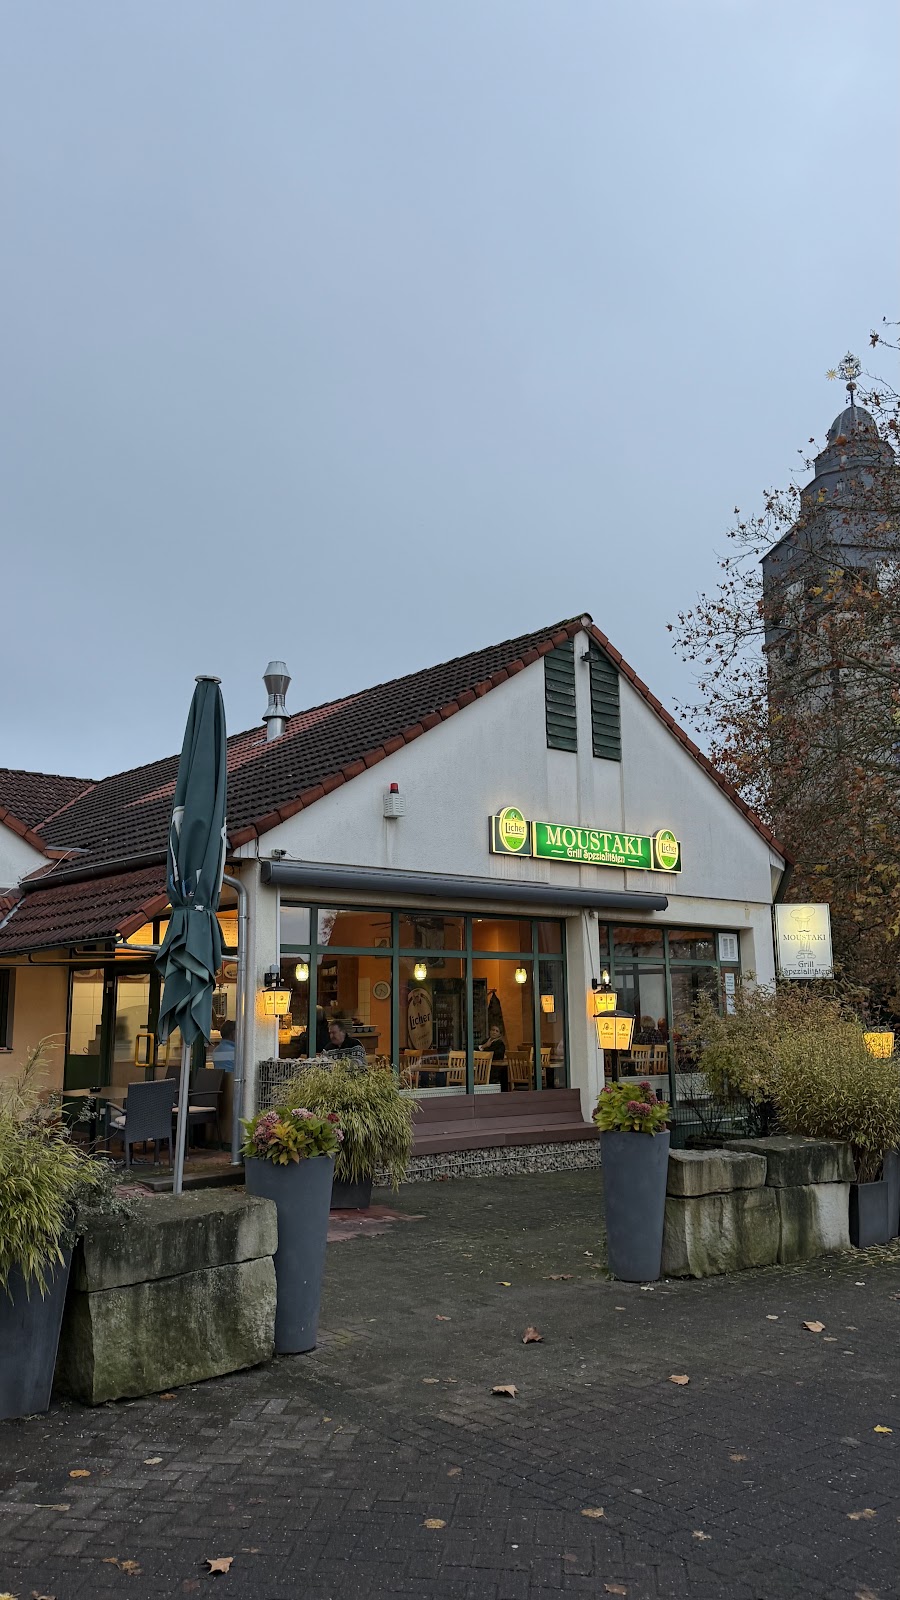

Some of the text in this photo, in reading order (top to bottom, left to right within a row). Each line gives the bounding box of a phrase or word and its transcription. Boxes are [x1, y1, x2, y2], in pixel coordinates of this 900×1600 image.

[505, 822, 525, 834] Licher
[545, 825, 644, 856] MOUSTAKI
[567, 847, 582, 858] Grill
[661, 842, 677, 853] Licher
[409, 1012, 430, 1030] Licher
